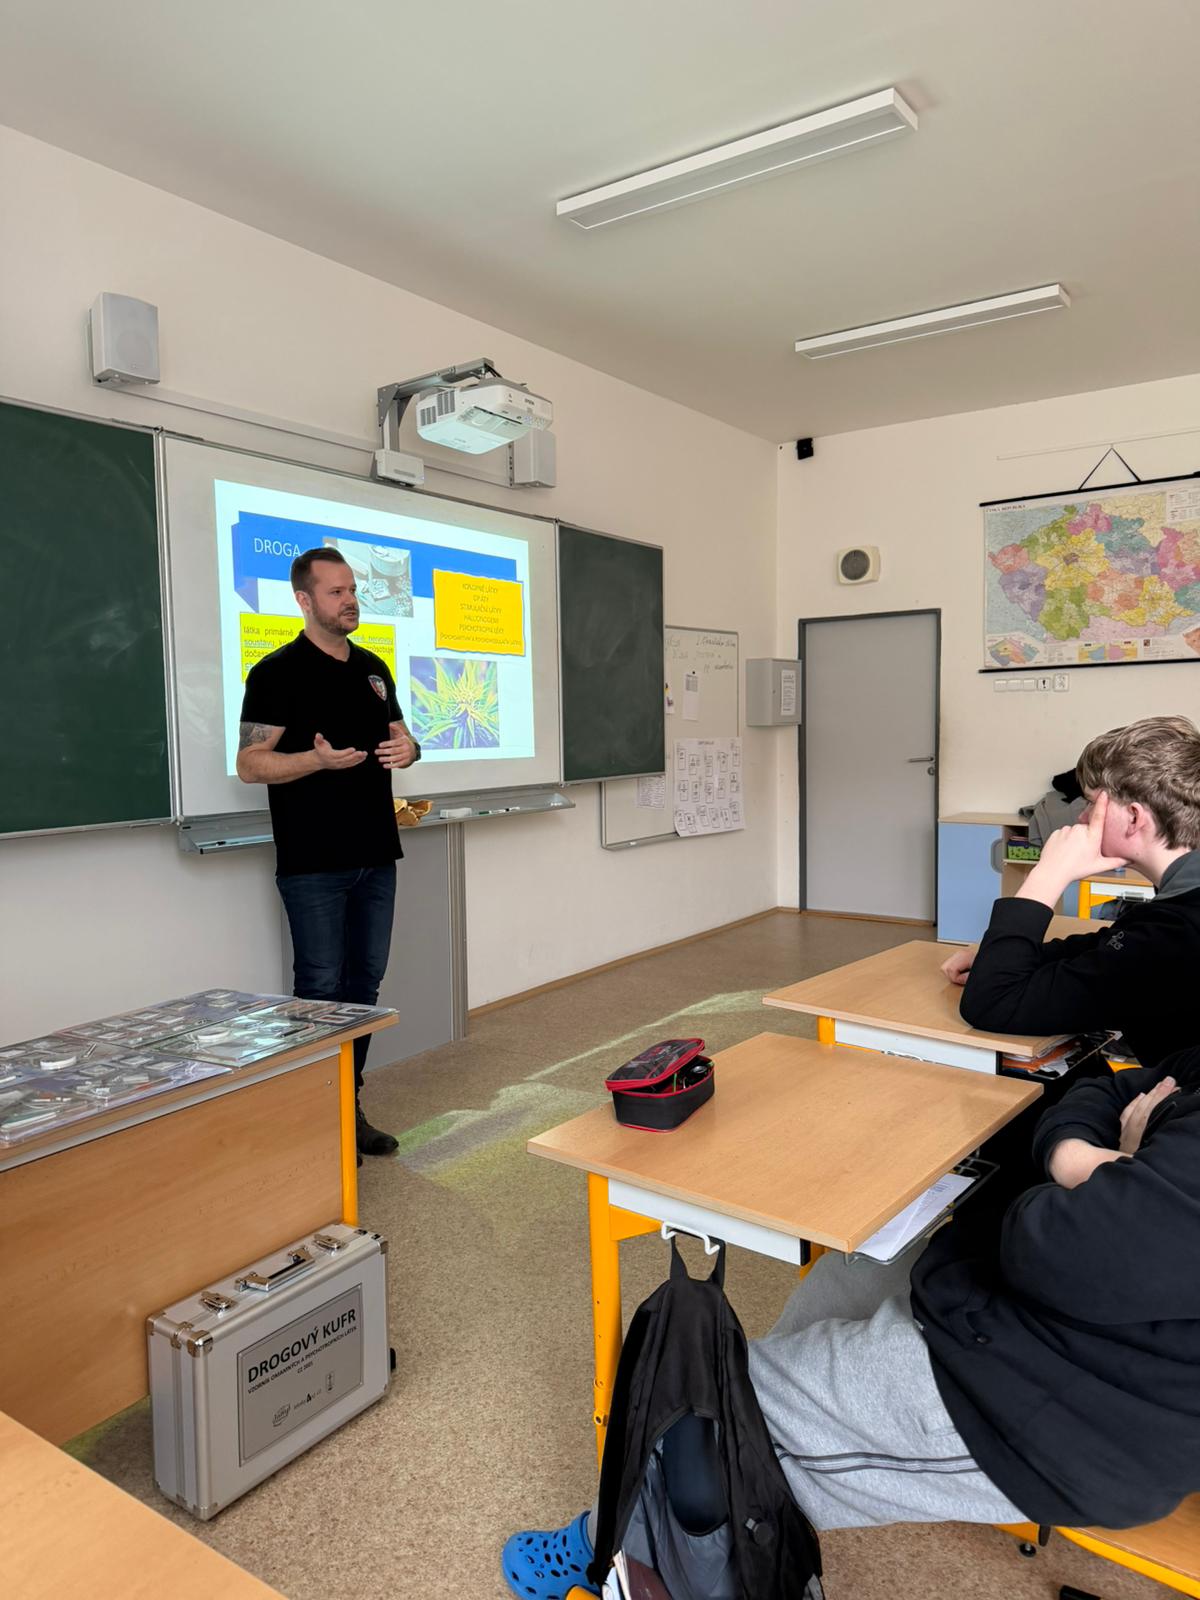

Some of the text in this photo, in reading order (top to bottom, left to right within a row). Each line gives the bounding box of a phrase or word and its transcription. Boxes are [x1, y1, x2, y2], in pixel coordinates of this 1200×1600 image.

[254, 537, 300, 557] DROGA
[248, 1309, 356, 1383] DROGOVÝ KUFR
